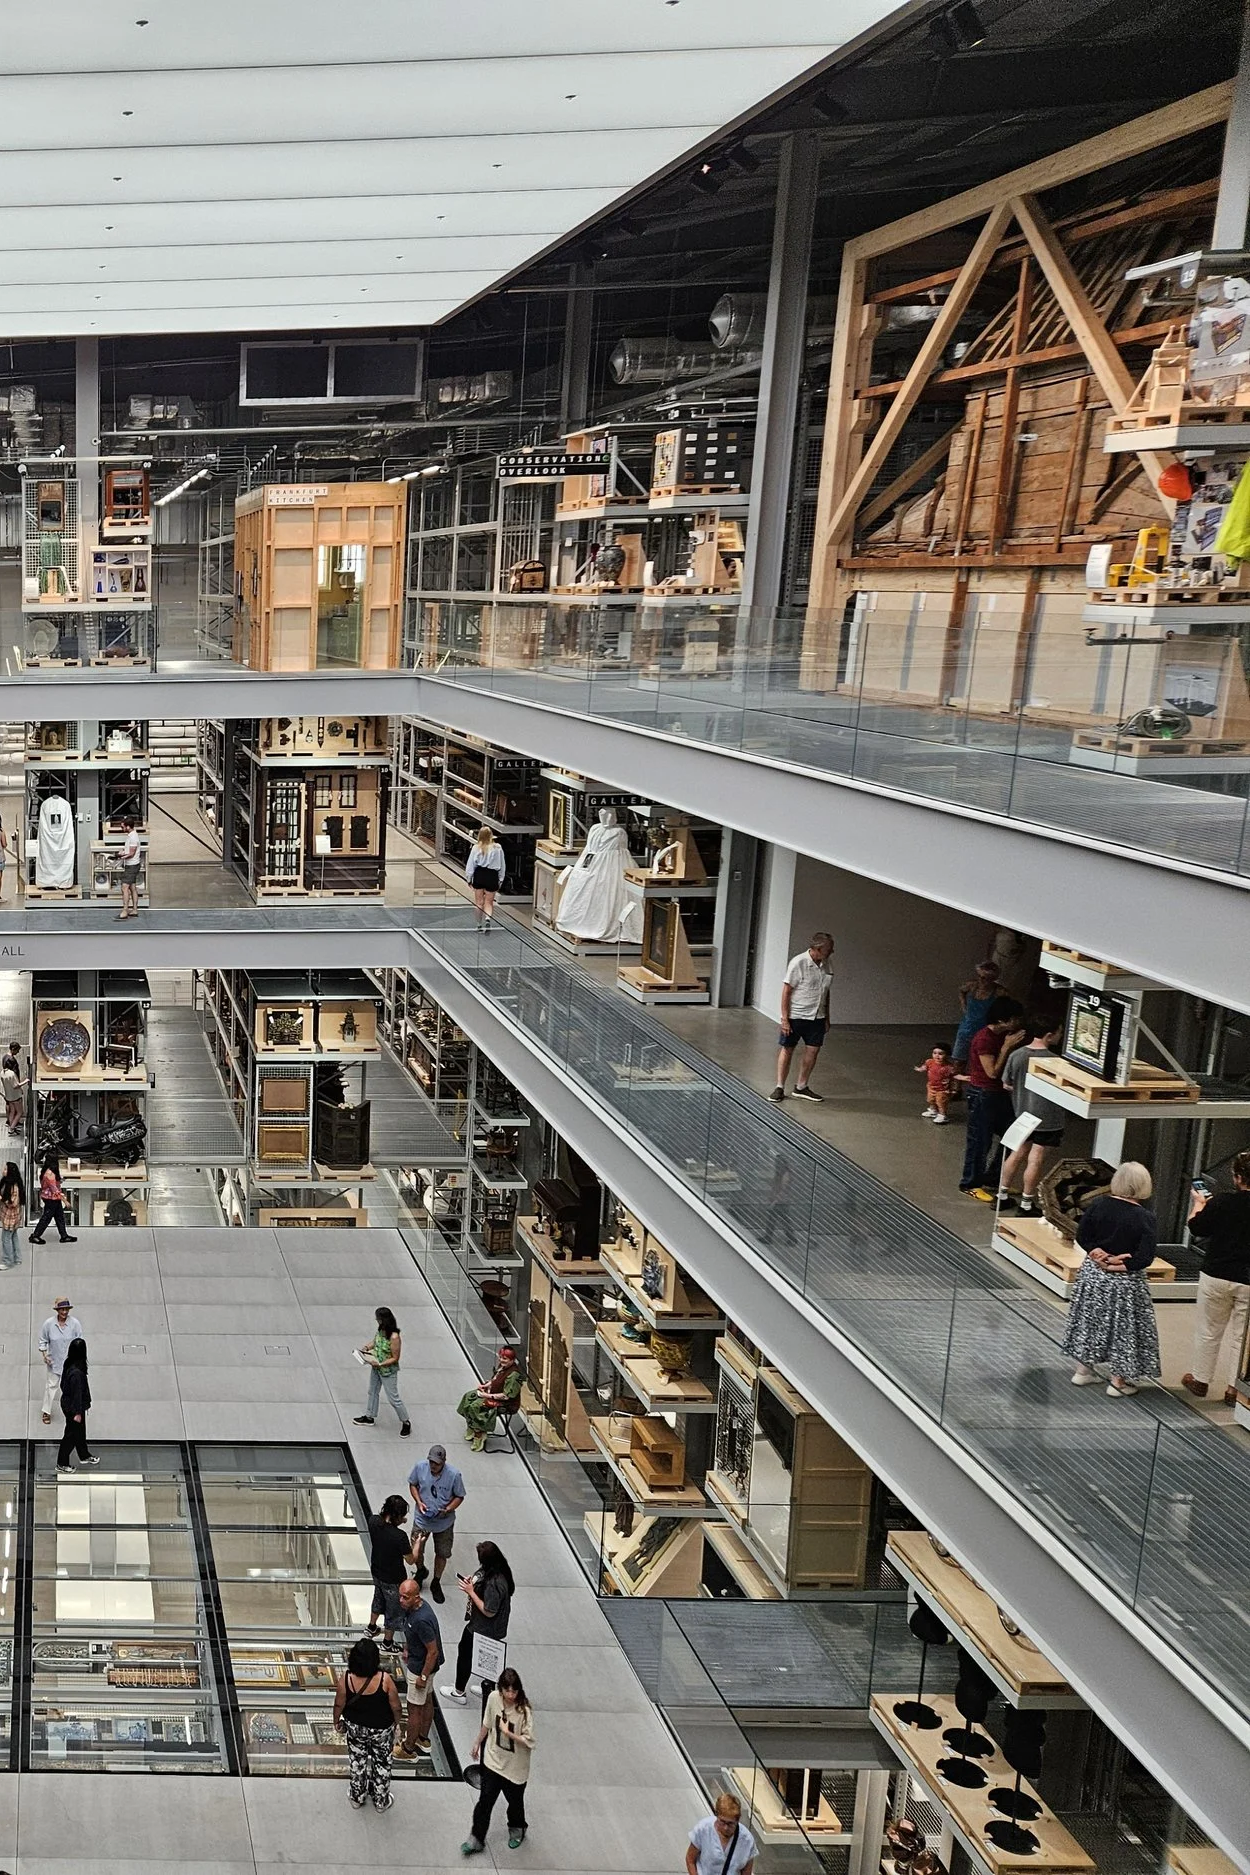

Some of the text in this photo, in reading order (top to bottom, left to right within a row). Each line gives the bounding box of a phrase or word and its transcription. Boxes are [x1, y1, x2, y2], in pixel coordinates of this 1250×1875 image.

[1181, 269, 1196, 283] 19
[500, 455, 601, 465] CONSERVATION
[499, 467, 566, 476] OVERLOOK
[1088, 994, 1101, 1007] 19
